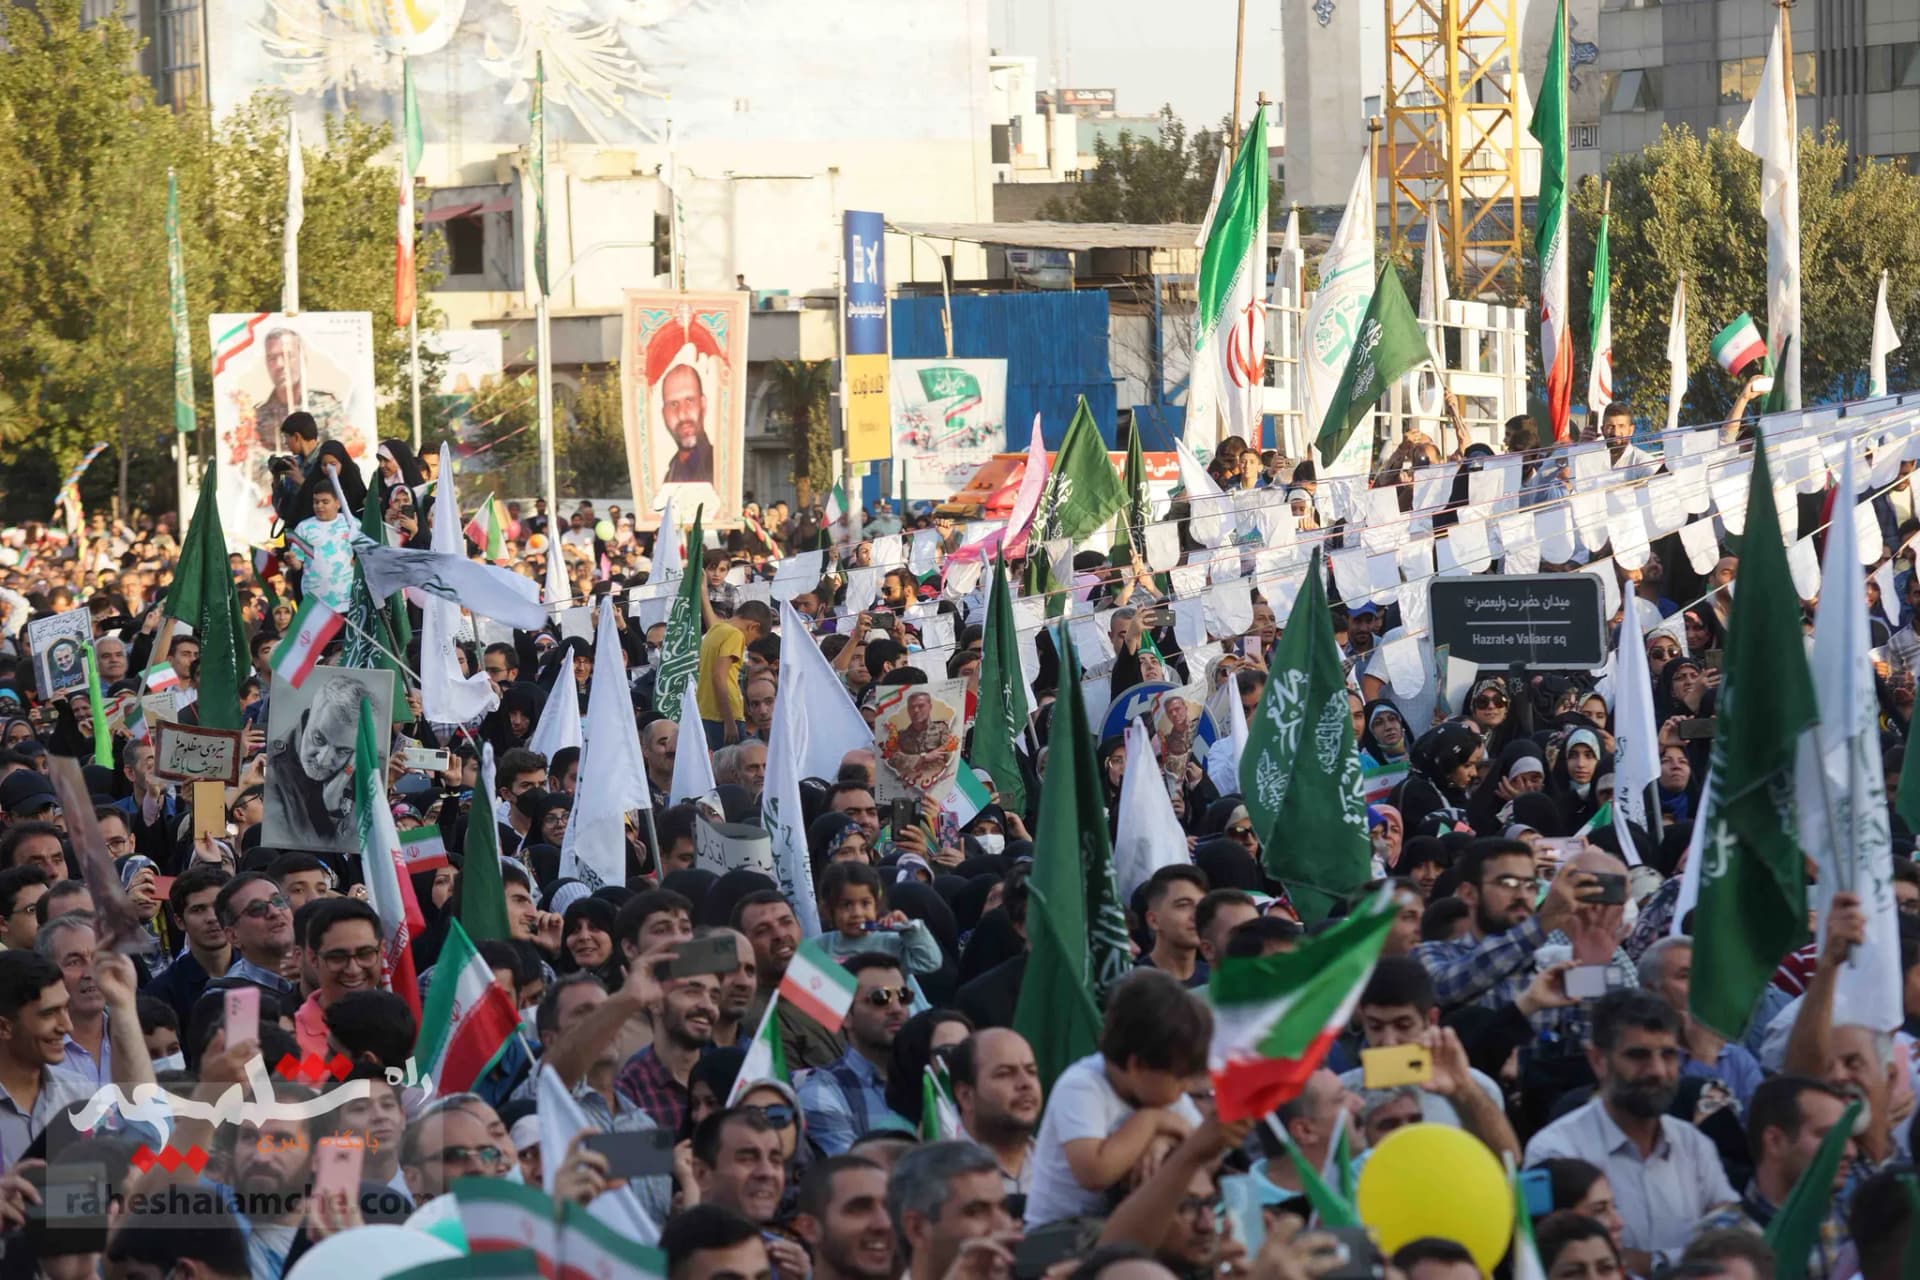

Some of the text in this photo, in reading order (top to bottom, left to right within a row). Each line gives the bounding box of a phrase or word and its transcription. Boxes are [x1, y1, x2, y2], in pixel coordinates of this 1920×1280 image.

[1508, 594, 1540, 612] حضرت
[1542, 595, 1571, 611] میدان
[1472, 633, 1567, 647] Hazrat-e Valiasr sq
